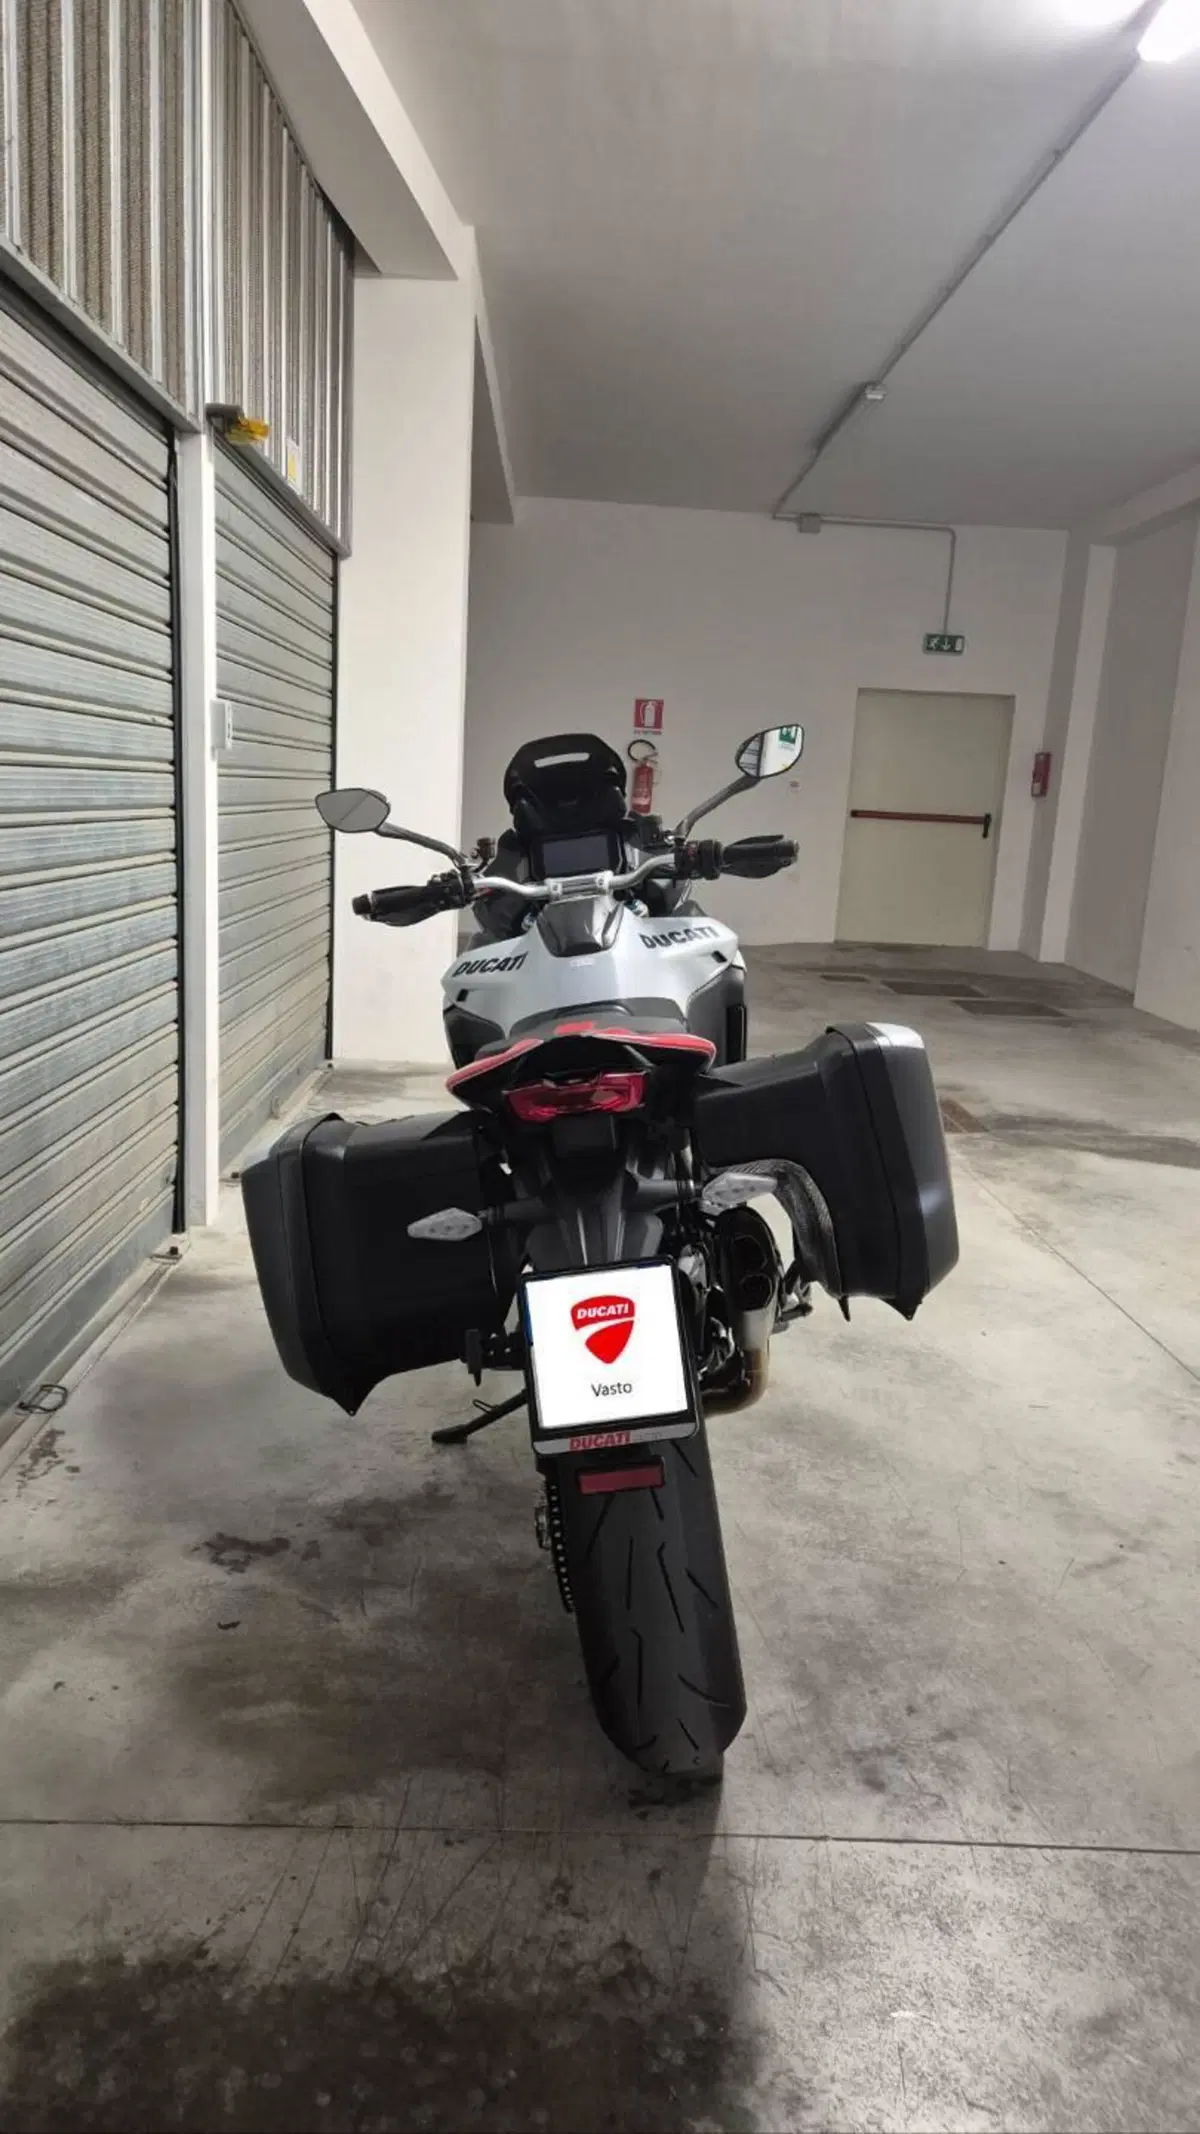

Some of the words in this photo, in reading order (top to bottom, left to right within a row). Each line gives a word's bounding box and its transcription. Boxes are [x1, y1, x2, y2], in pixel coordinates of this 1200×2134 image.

[640, 926, 719, 949] DUCATI
[452, 952, 528, 977] DUCATI
[570, 1432, 630, 1450] DUCATI
